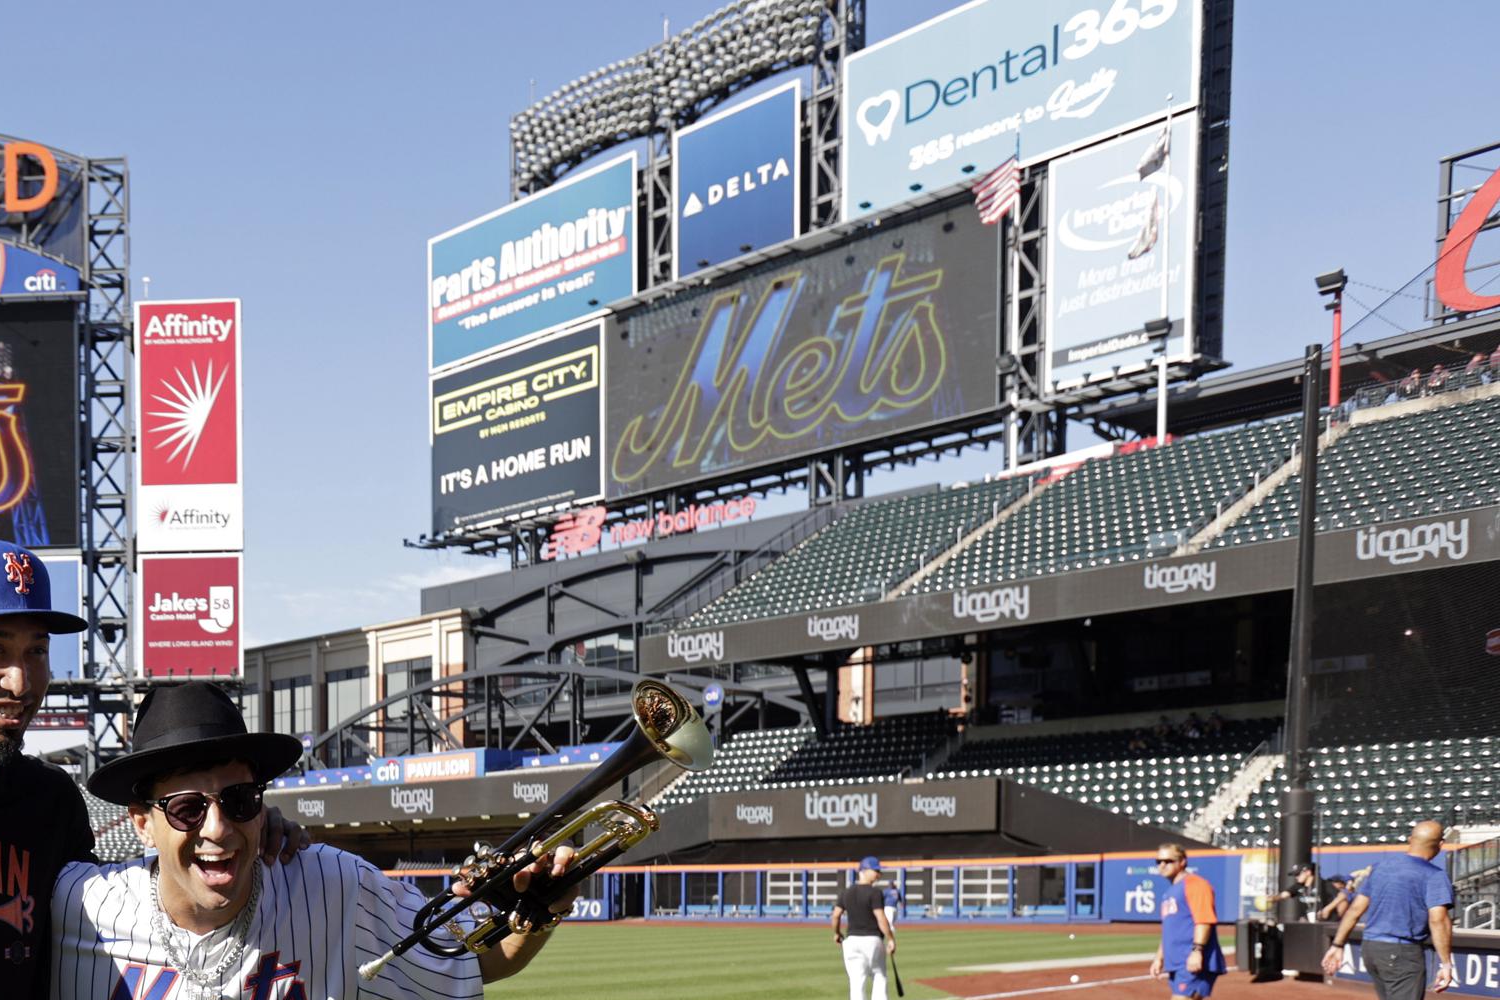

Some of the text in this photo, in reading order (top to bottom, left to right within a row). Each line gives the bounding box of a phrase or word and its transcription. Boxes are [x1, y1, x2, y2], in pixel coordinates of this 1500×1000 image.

[908, 133, 956, 170] 365
[1024, 105, 1045, 124] to
[708, 158, 790, 206] DELTA
[432, 207, 627, 308] Parts Authority
[24, 270, 56, 291] citi
[489, 292, 540, 320] Answer
[144, 313, 233, 342] Affinity
[612, 253, 944, 483] Mets
[442, 360, 587, 421] EMPIRE CITY
[485, 395, 539, 421] CASINO
[441, 436, 590, 494] IT'S A HOME RUN
[169, 509, 230, 528] Affinity
[610, 497, 756, 544] new balance
[1356, 518, 1470, 565] timmy
[1143, 561, 1217, 593] timmy
[148, 592, 208, 612] Jake's
[213, 599, 231, 610] 58
[953, 585, 1029, 623] timmy
[667, 630, 724, 663] timmy
[376, 759, 470, 781] citi PAVILION
[805, 791, 878, 828] timmy
[1125, 885, 1155, 913] rts
